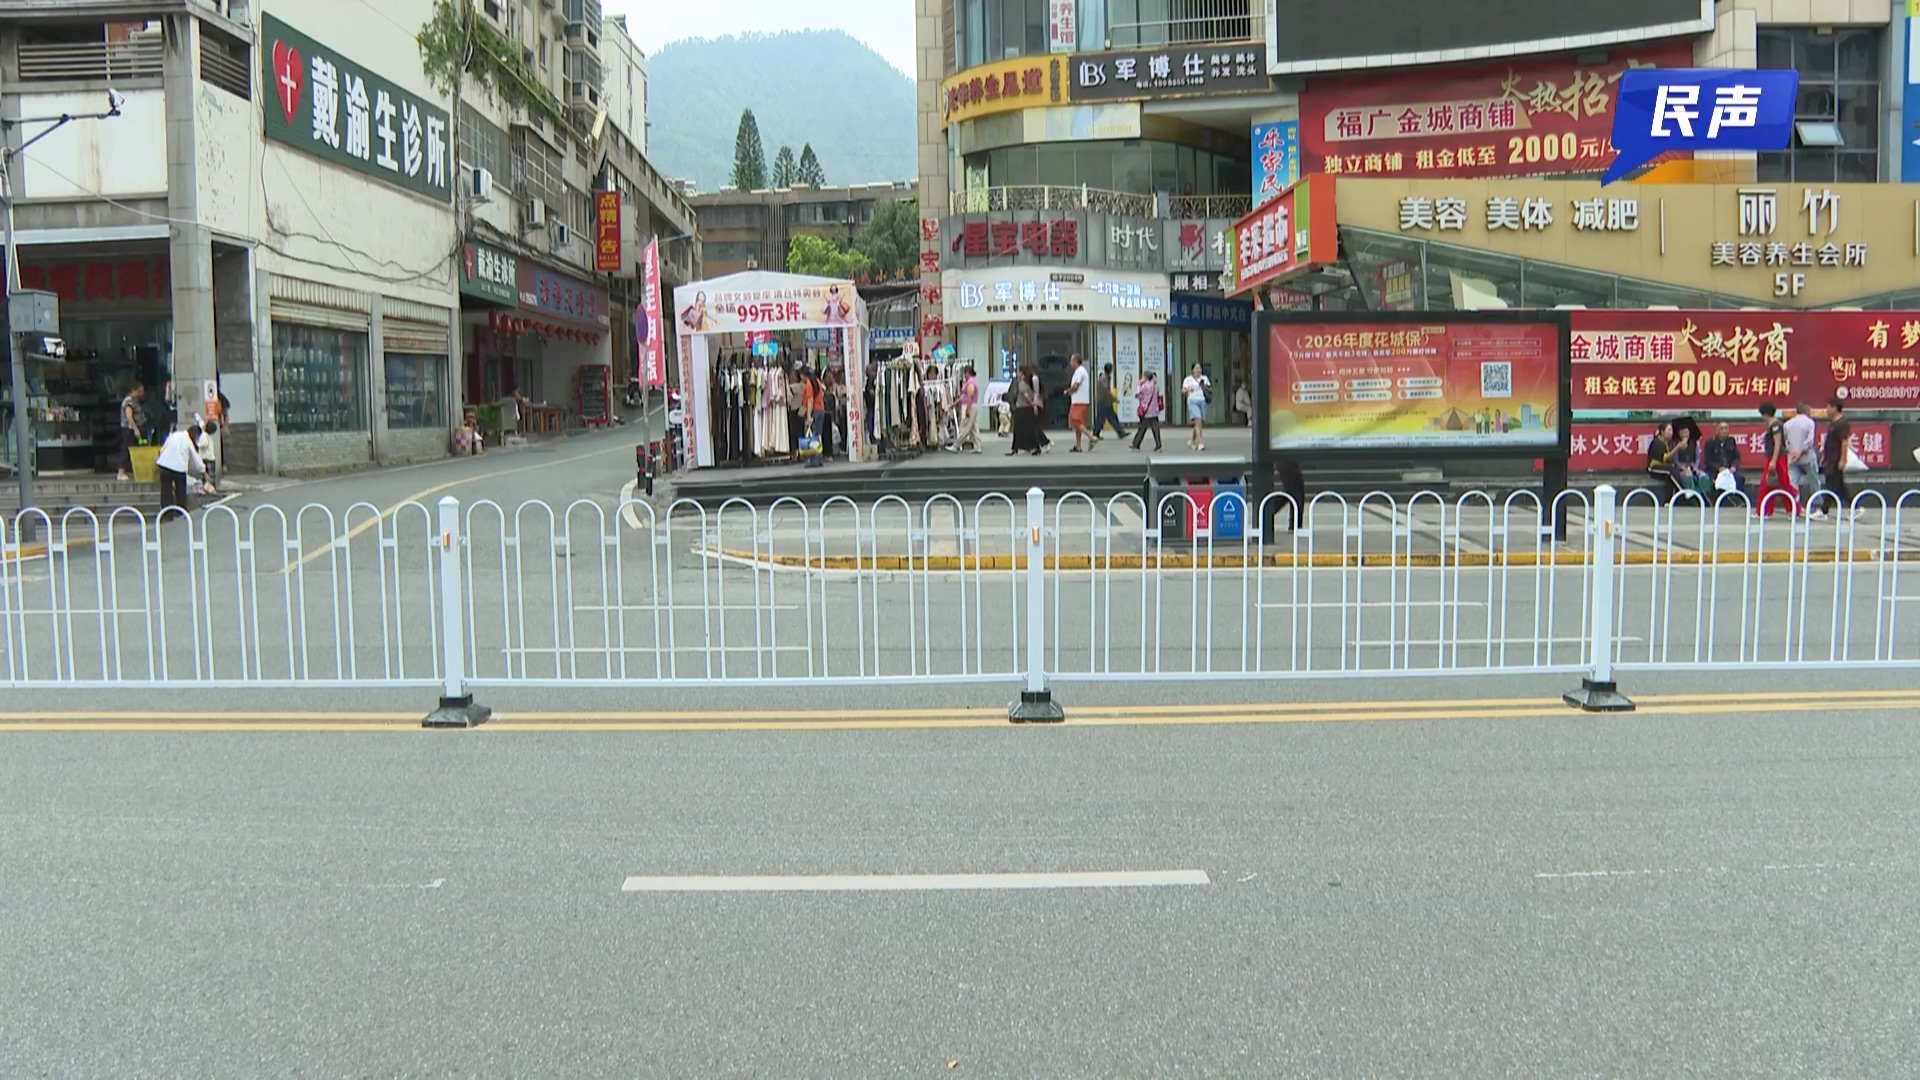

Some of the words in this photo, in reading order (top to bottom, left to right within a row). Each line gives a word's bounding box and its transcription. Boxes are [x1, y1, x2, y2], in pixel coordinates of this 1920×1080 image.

[1115, 53, 1204, 81] 军博仕
[311, 56, 446, 188] 戴渝生诊所
[1336, 102, 1516, 138] 福广金城商铺
[1324, 155, 1403, 174] 独立商铺
[1416, 146, 1496, 170] 租金低至
[1400, 196, 1467, 232] 美容
[1486, 196, 1553, 232] 美体
[1572, 198, 1639, 231] 减肥
[1738, 188, 1841, 236] 丽竹
[964, 219, 1078, 257] 星宝电器
[1110, 224, 1159, 251] 时代
[1711, 242, 1867, 266] 美容养生会所
[994, 280, 1061, 302] 军博仕
[1174, 275, 1208, 291] 照相
[1773, 273, 1806, 297] 5F
[1304, 330, 1422, 349] 2026年度花城保
[1571, 334, 1675, 361] 金城商铺
[1679, 318, 1794, 370] 火热招商
[1585, 375, 1656, 395] 租金低至
[1667, 370, 1791, 396] 2000元/年/间
